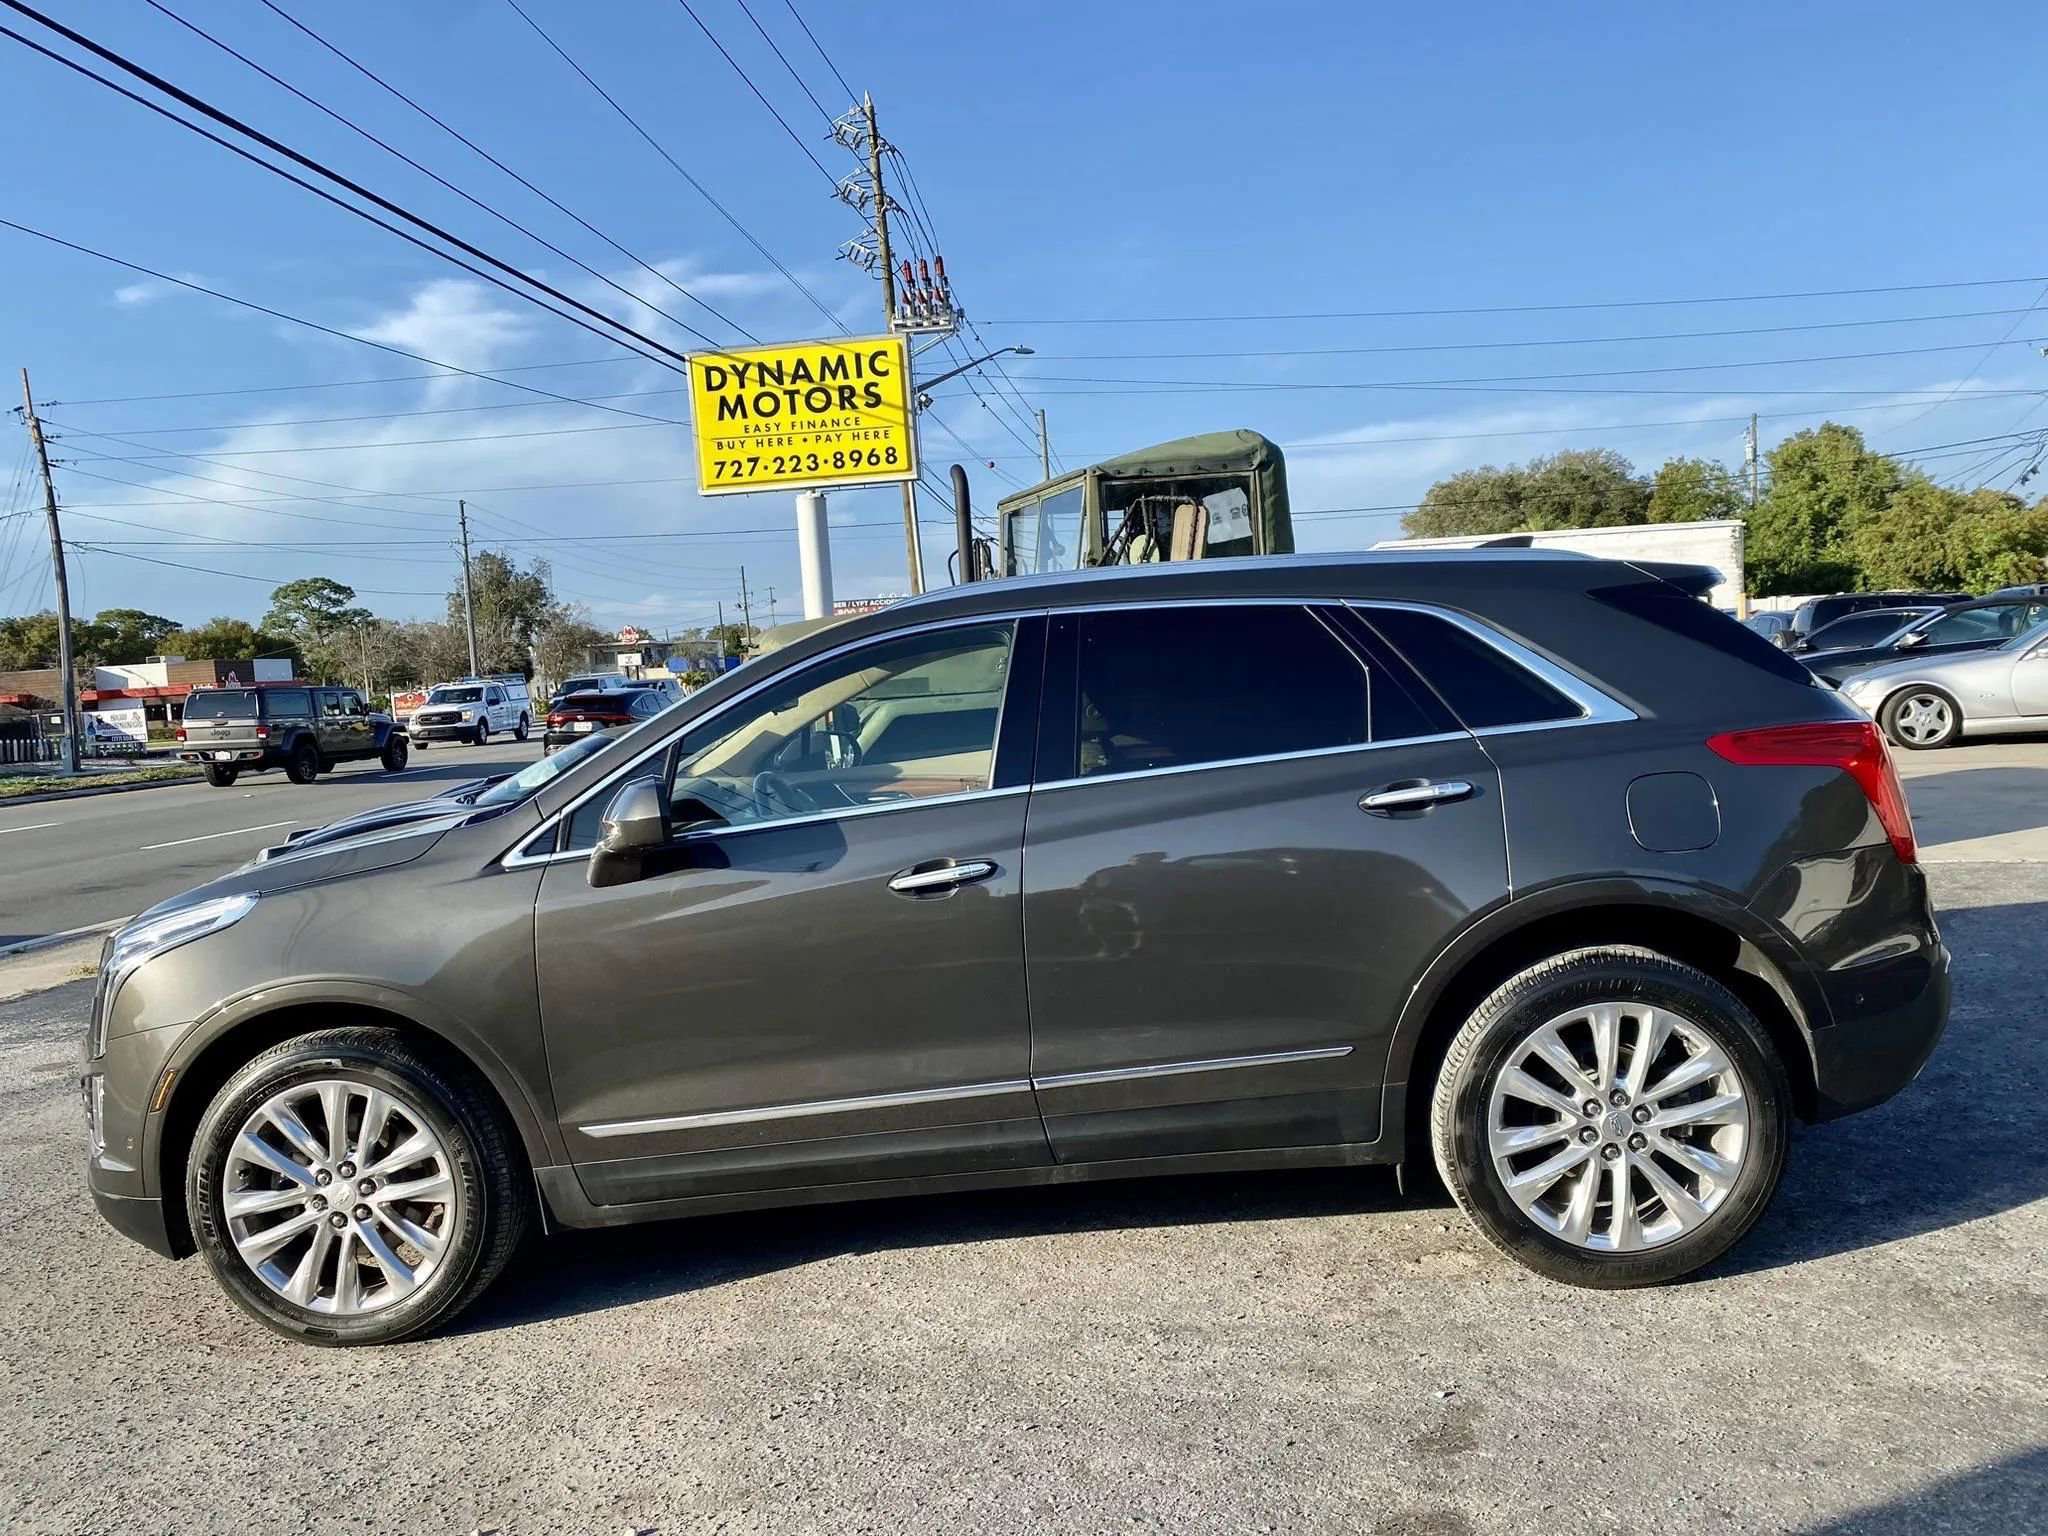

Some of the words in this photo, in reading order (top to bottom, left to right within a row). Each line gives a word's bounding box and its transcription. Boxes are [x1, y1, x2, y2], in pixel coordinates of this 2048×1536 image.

[704, 350, 890, 392] DYNAMIC
[717, 381, 882, 421] MOTORS
[716, 439, 747, 451] BUY
[756, 436, 794, 448] HERE
[815, 432, 843, 444] PAY
[852, 429, 891, 441] HERE
[743, 422, 782, 434] EASY
[791, 416, 861, 431] FINANCE
